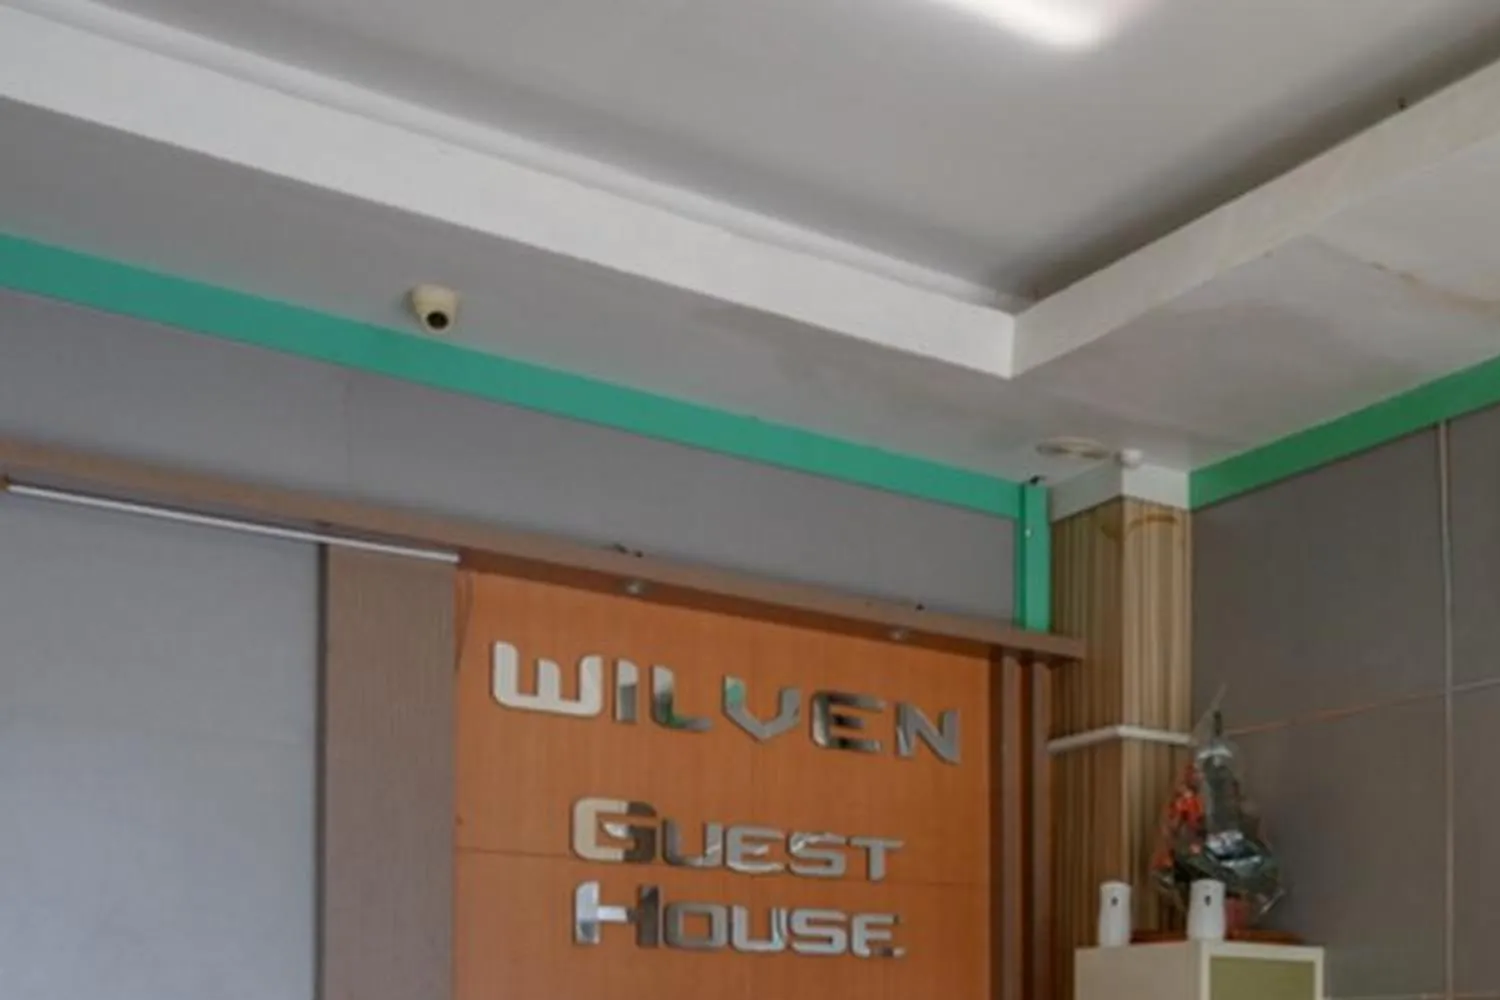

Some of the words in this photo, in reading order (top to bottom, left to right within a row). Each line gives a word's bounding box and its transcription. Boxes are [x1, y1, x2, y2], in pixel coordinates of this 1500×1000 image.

[492, 640, 962, 766] WILVEN
[572, 796, 904, 882] GUEST
[574, 880, 905, 958] HOUSE
